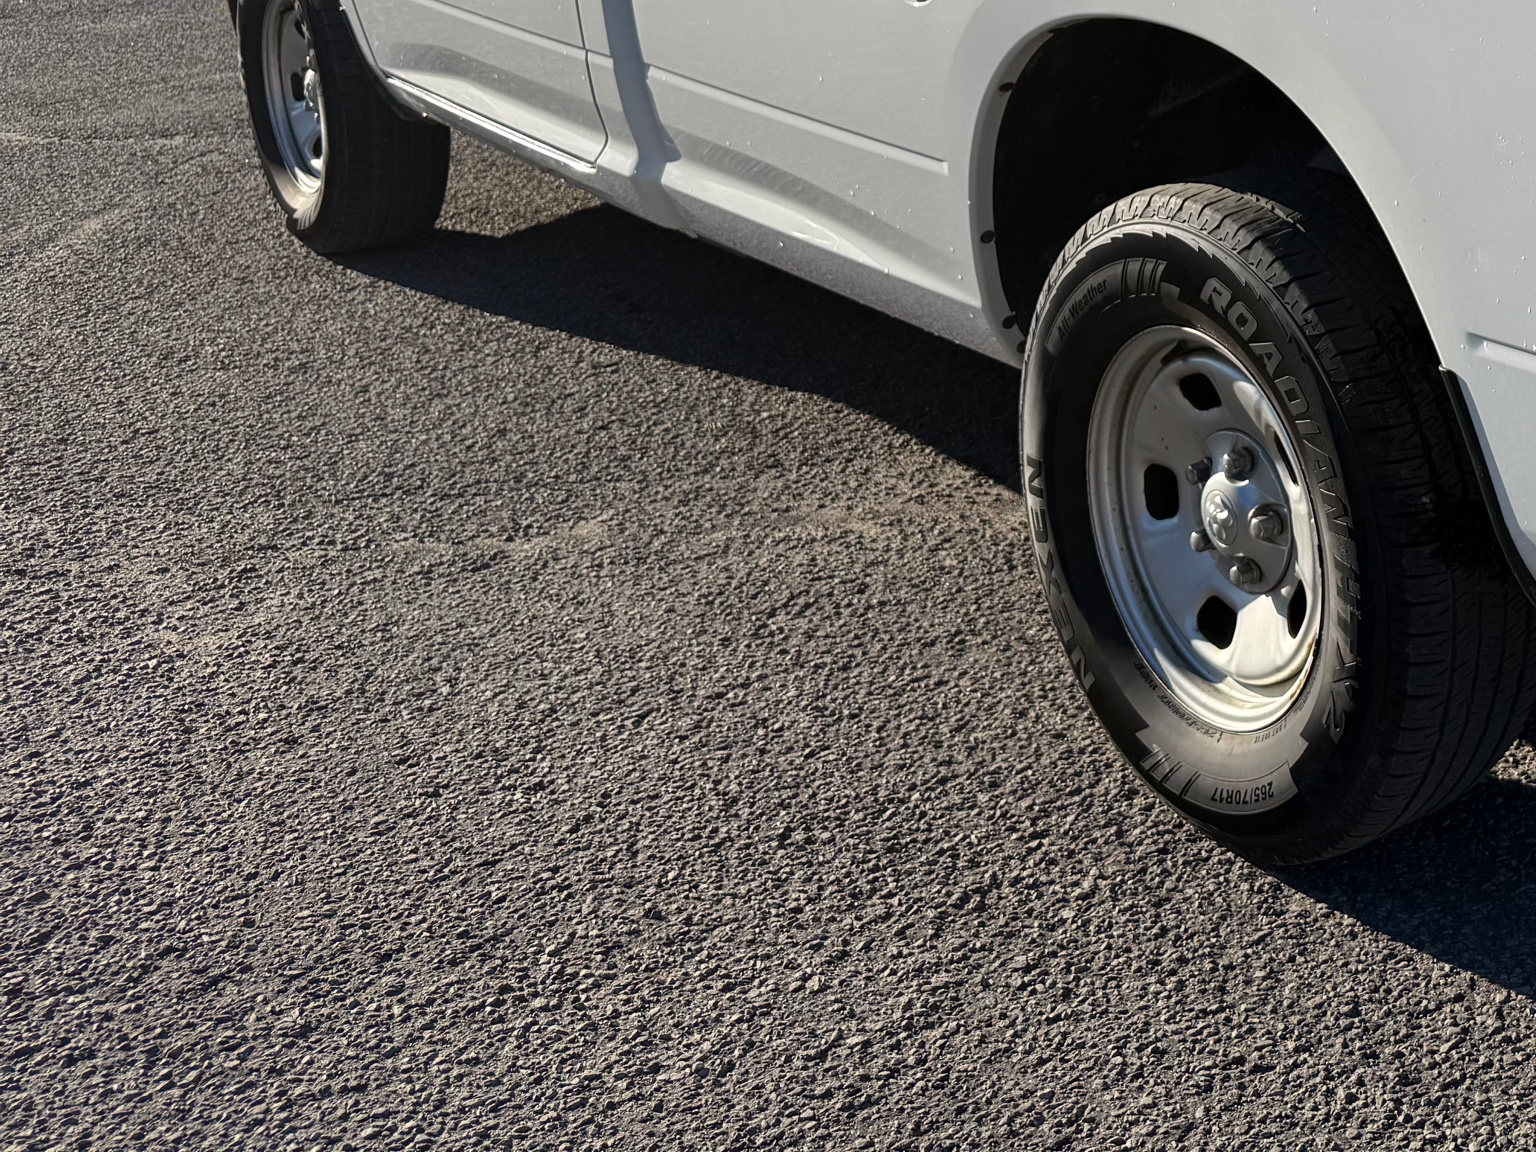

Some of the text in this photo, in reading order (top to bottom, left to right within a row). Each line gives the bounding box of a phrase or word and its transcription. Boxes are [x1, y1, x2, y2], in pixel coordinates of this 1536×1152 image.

[1057, 279, 1107, 340] All-Weather
[1200, 277, 1352, 539] ROADIAN
[1027, 453, 1097, 692] NEXEN
[1210, 780, 1274, 805] 265/70R17
